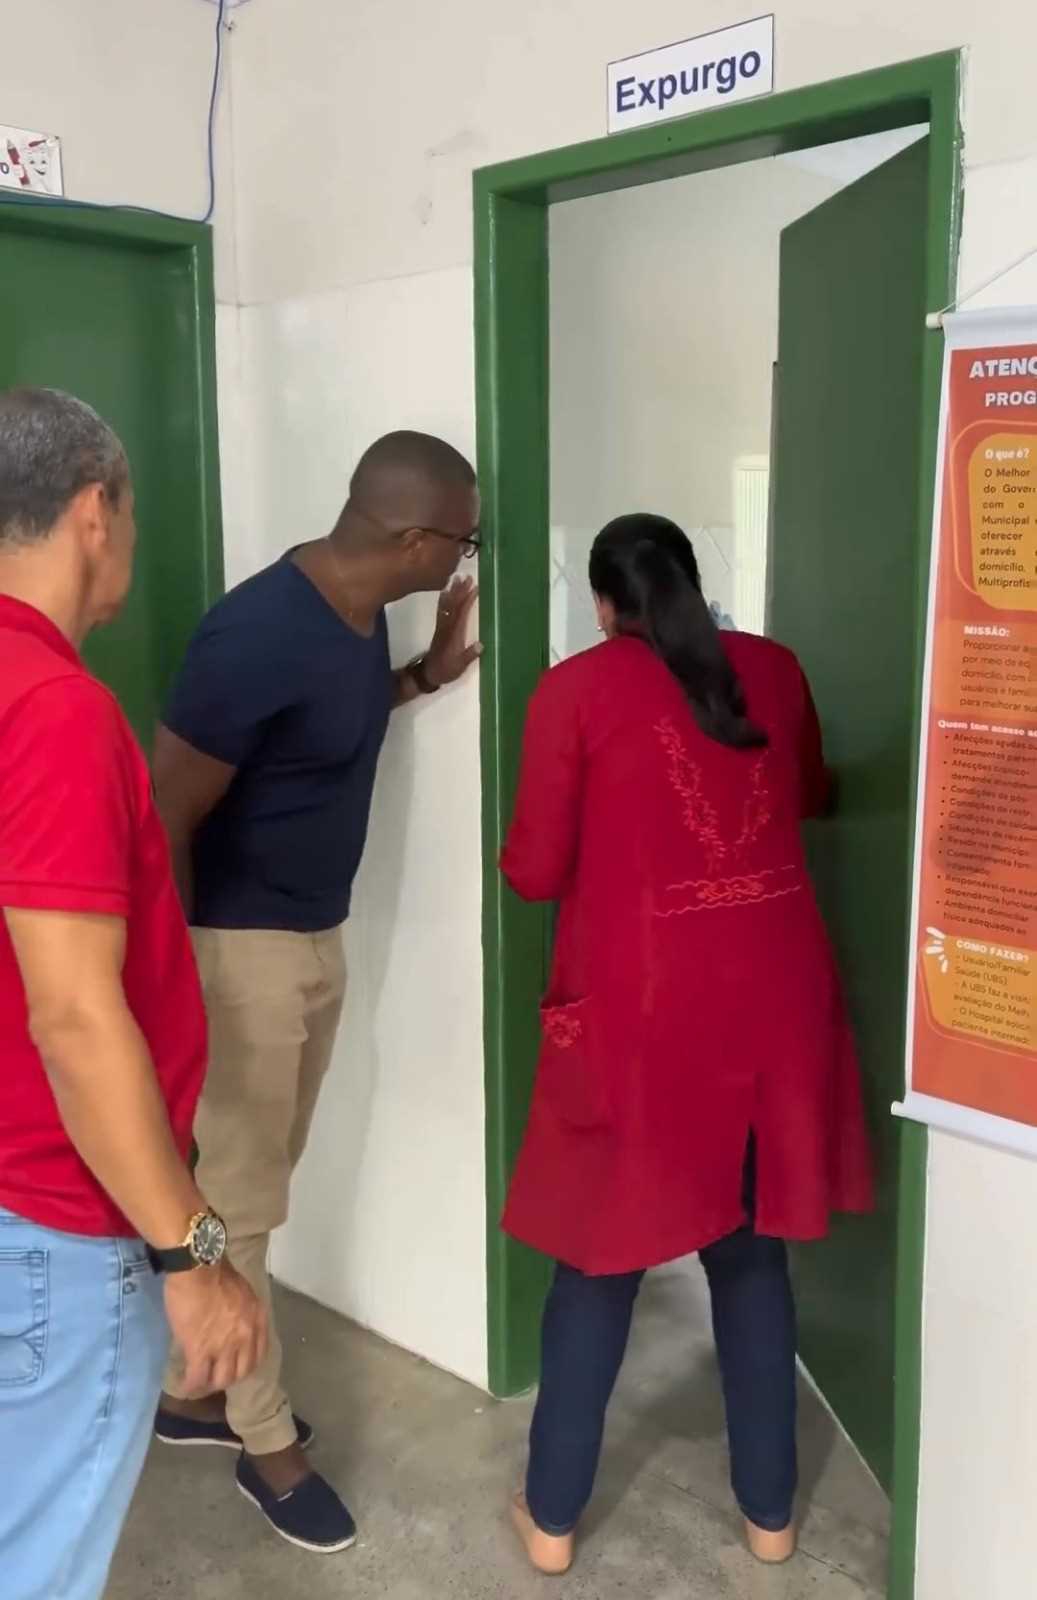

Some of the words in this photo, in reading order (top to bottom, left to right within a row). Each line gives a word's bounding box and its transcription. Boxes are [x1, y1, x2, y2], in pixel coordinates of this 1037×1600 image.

[616, 51, 761, 113] Expurgo
[985, 391, 1037, 407] PROG
[985, 449, 993, 459] O
[995, 450, 1015, 461] que
[984, 468, 992, 478] O
[996, 467, 1031, 477] Melhor
[984, 484, 996, 493] do
[982, 515, 1030, 527] Municipal
[981, 531, 1023, 540] oferecer
[980, 547, 1016, 556] através
[964, 625, 1010, 637] MISSÃO:
[962, 656, 978, 665] por
[938, 720, 968, 729] Quem
[970, 722, 989, 731] tem
[991, 725, 1025, 736] acesso
[956, 939, 988, 954] COMO
